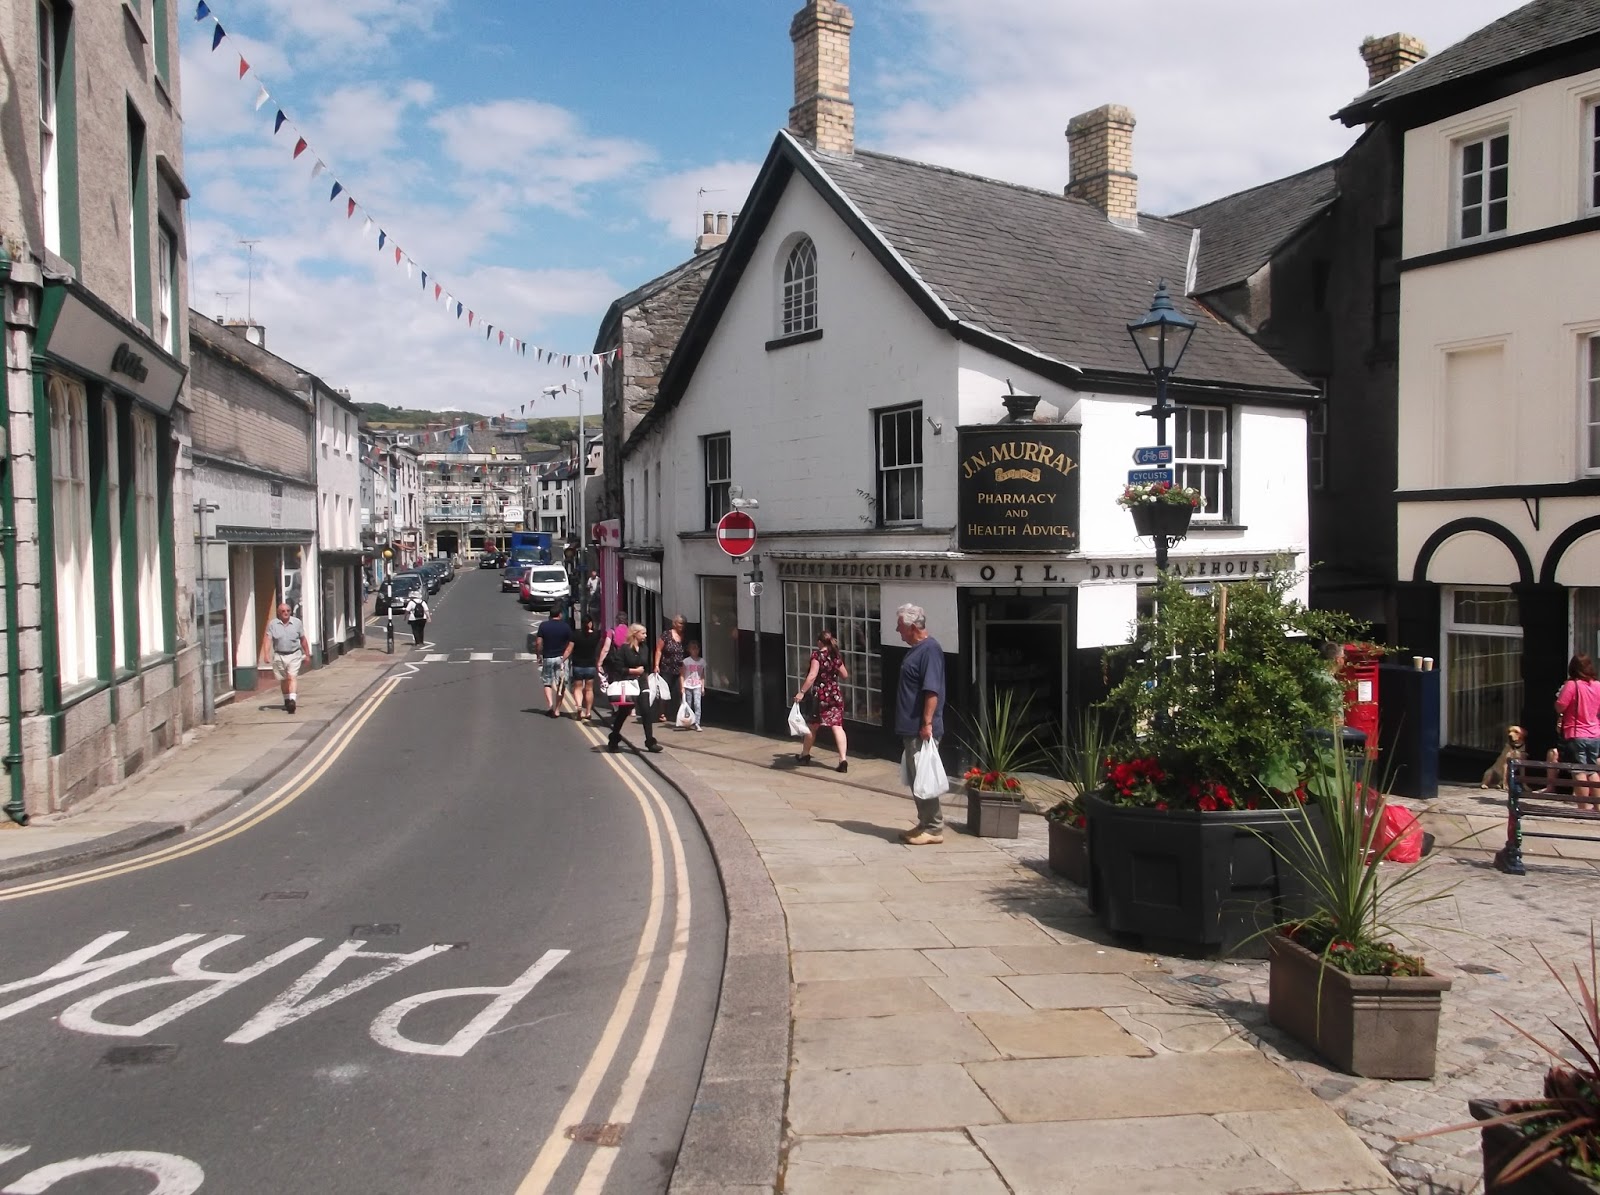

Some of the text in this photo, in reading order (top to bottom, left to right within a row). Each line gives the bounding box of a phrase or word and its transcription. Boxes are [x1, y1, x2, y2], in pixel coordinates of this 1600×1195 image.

[1133, 472, 1167, 480] CYCLISTS
[978, 493, 1057, 504] PHARMACY
[1005, 509, 1029, 518] AND
[968, 523, 1069, 536] HEALTH ADVICE
[1091, 564, 1144, 579] DRUG
[0, 930, 572, 1057] PARK
